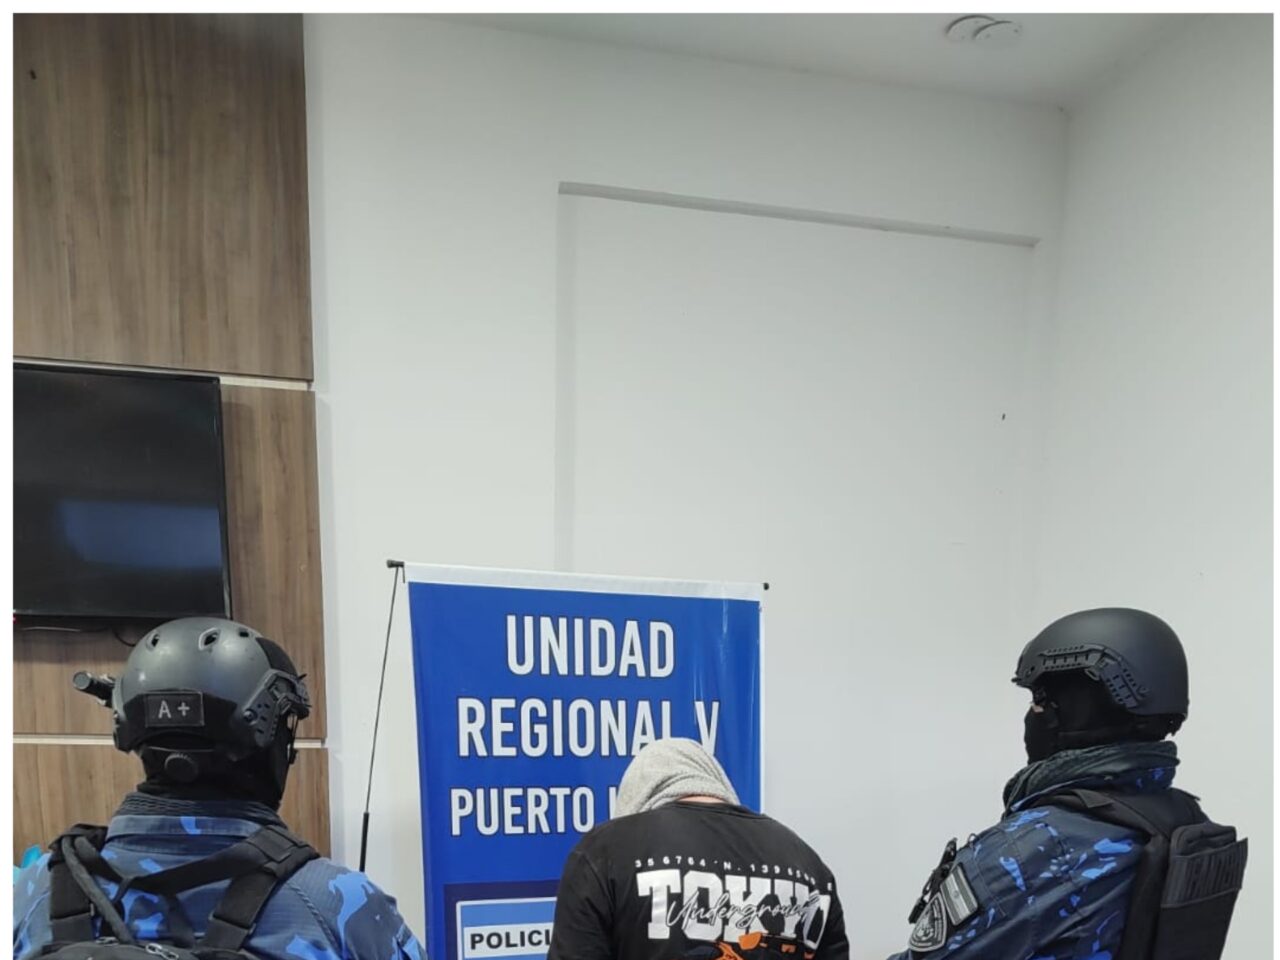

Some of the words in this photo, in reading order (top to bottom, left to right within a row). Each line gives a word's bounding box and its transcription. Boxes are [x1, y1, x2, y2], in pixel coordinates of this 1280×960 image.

[506, 614, 675, 678] UNIDAD
[694, 700, 719, 756] V
[450, 786, 594, 837] PUERTO
[636, 869, 831, 950] TOKYO
